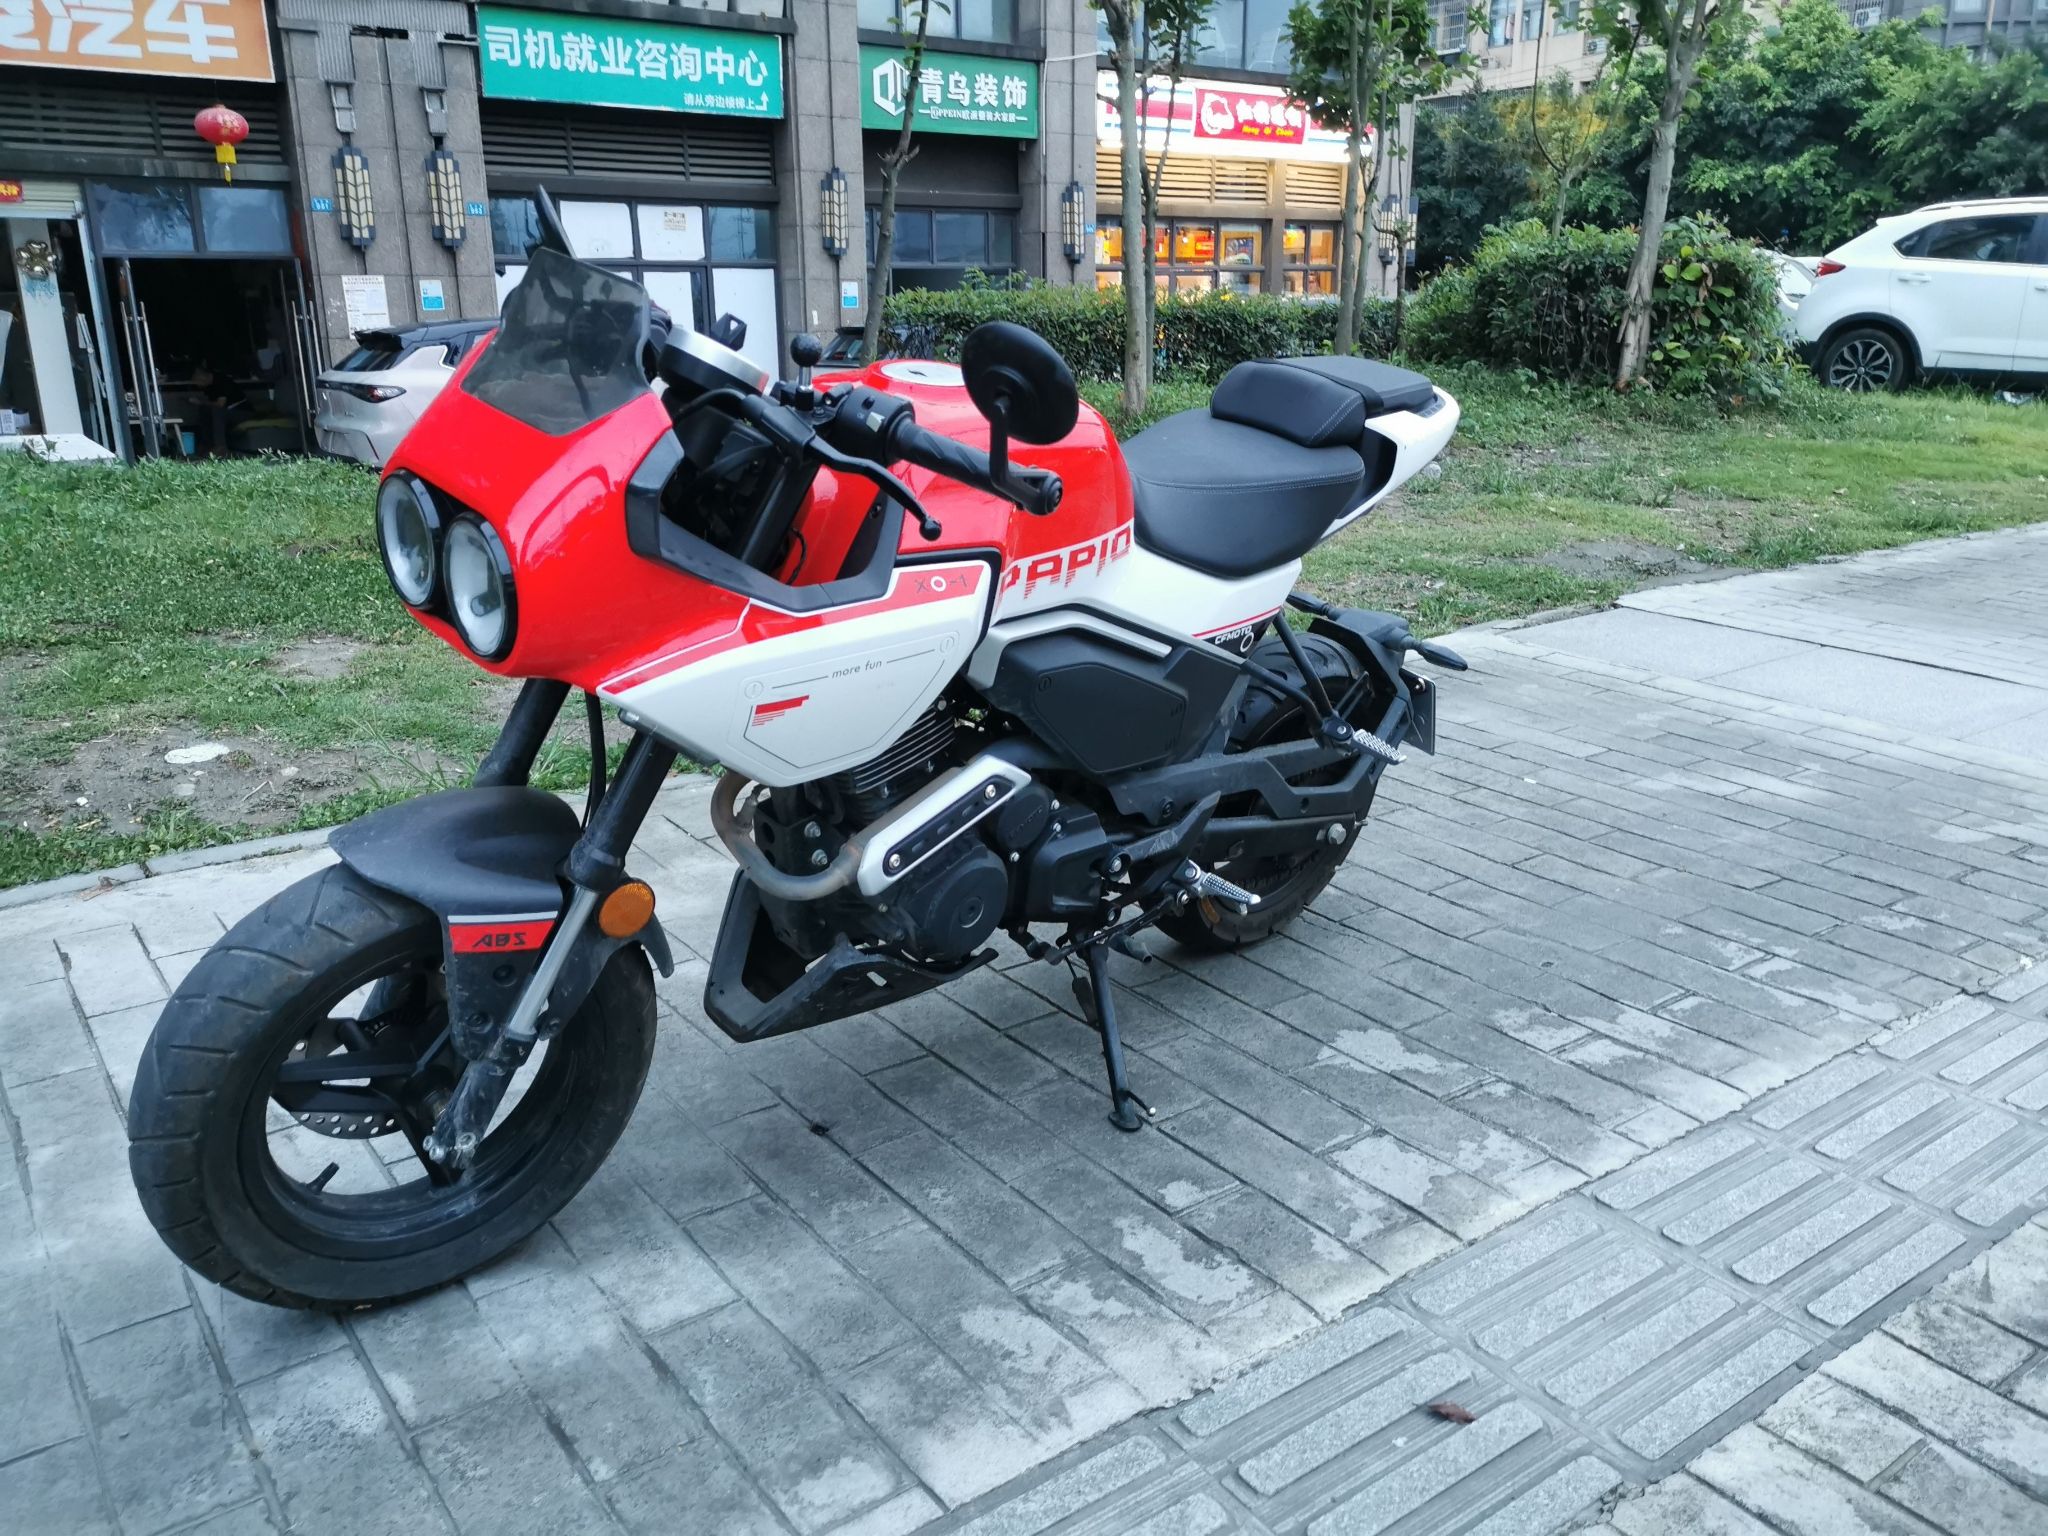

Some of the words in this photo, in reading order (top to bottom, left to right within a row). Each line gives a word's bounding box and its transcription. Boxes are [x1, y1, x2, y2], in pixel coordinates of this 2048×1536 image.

[485, 25, 768, 87] 司机就业咨询中心
[1214, 625, 1253, 645] CFMOTO
[831, 665, 861, 679] more
[864, 659, 882, 671] fun
[471, 931, 528, 949] ABS
